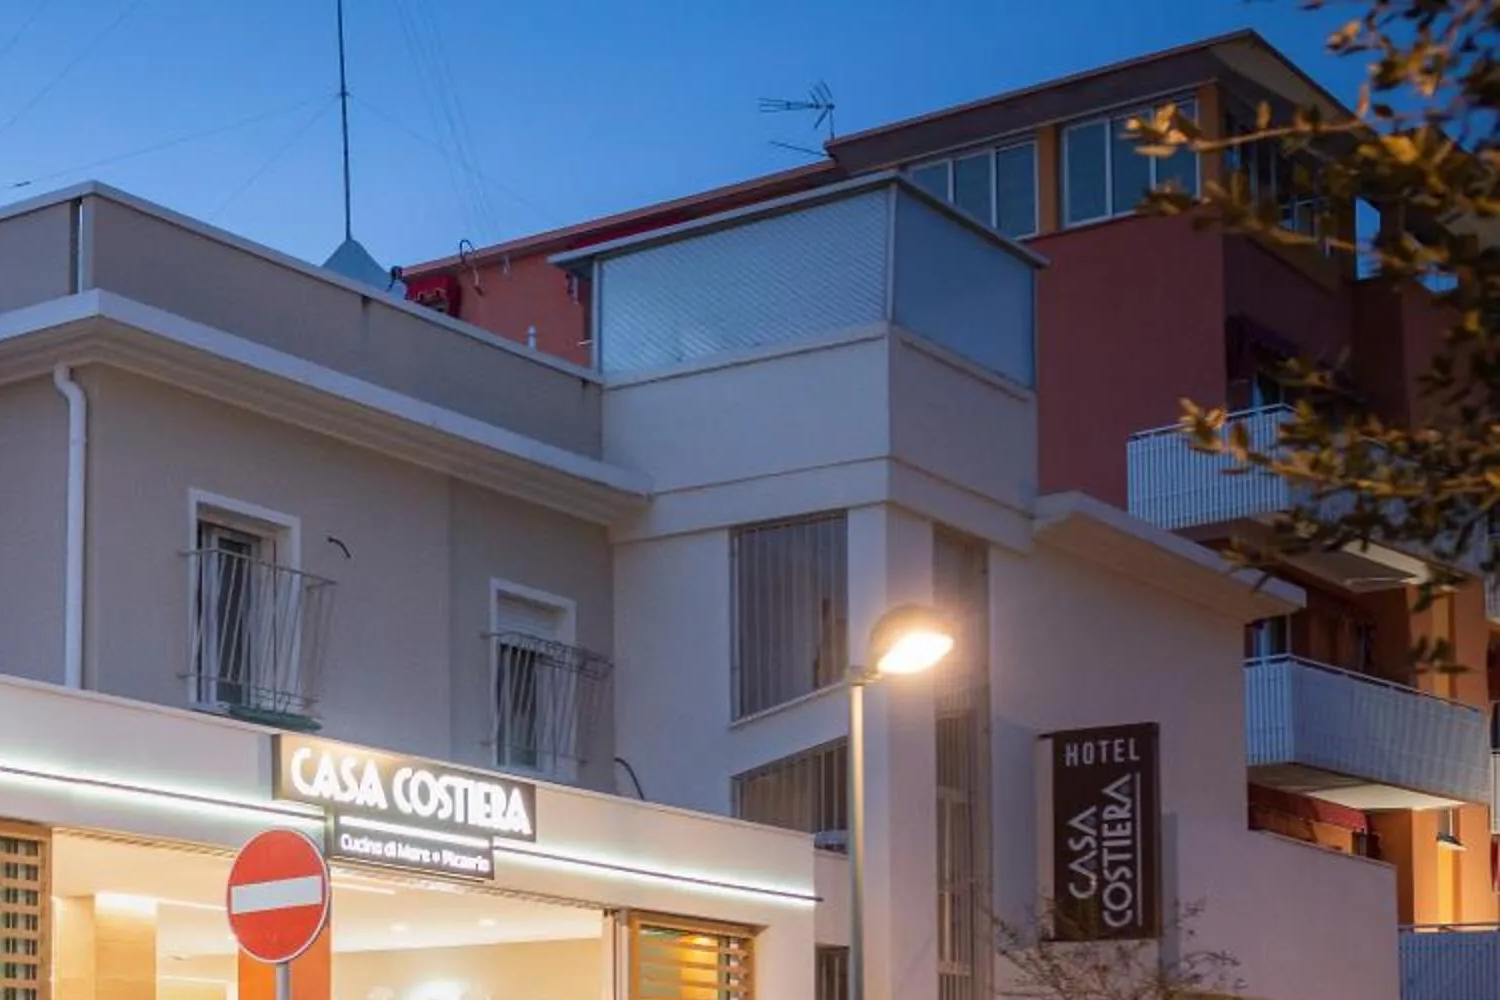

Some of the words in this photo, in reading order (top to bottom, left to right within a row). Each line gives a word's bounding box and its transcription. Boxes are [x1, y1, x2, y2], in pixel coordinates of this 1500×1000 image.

[290, 748, 388, 809] CASA
[393, 766, 533, 836] COSTIERA
[1065, 738, 1140, 767] HOTEL
[1067, 805, 1098, 899] CASA
[1102, 773, 1133, 928] COSTIERA
